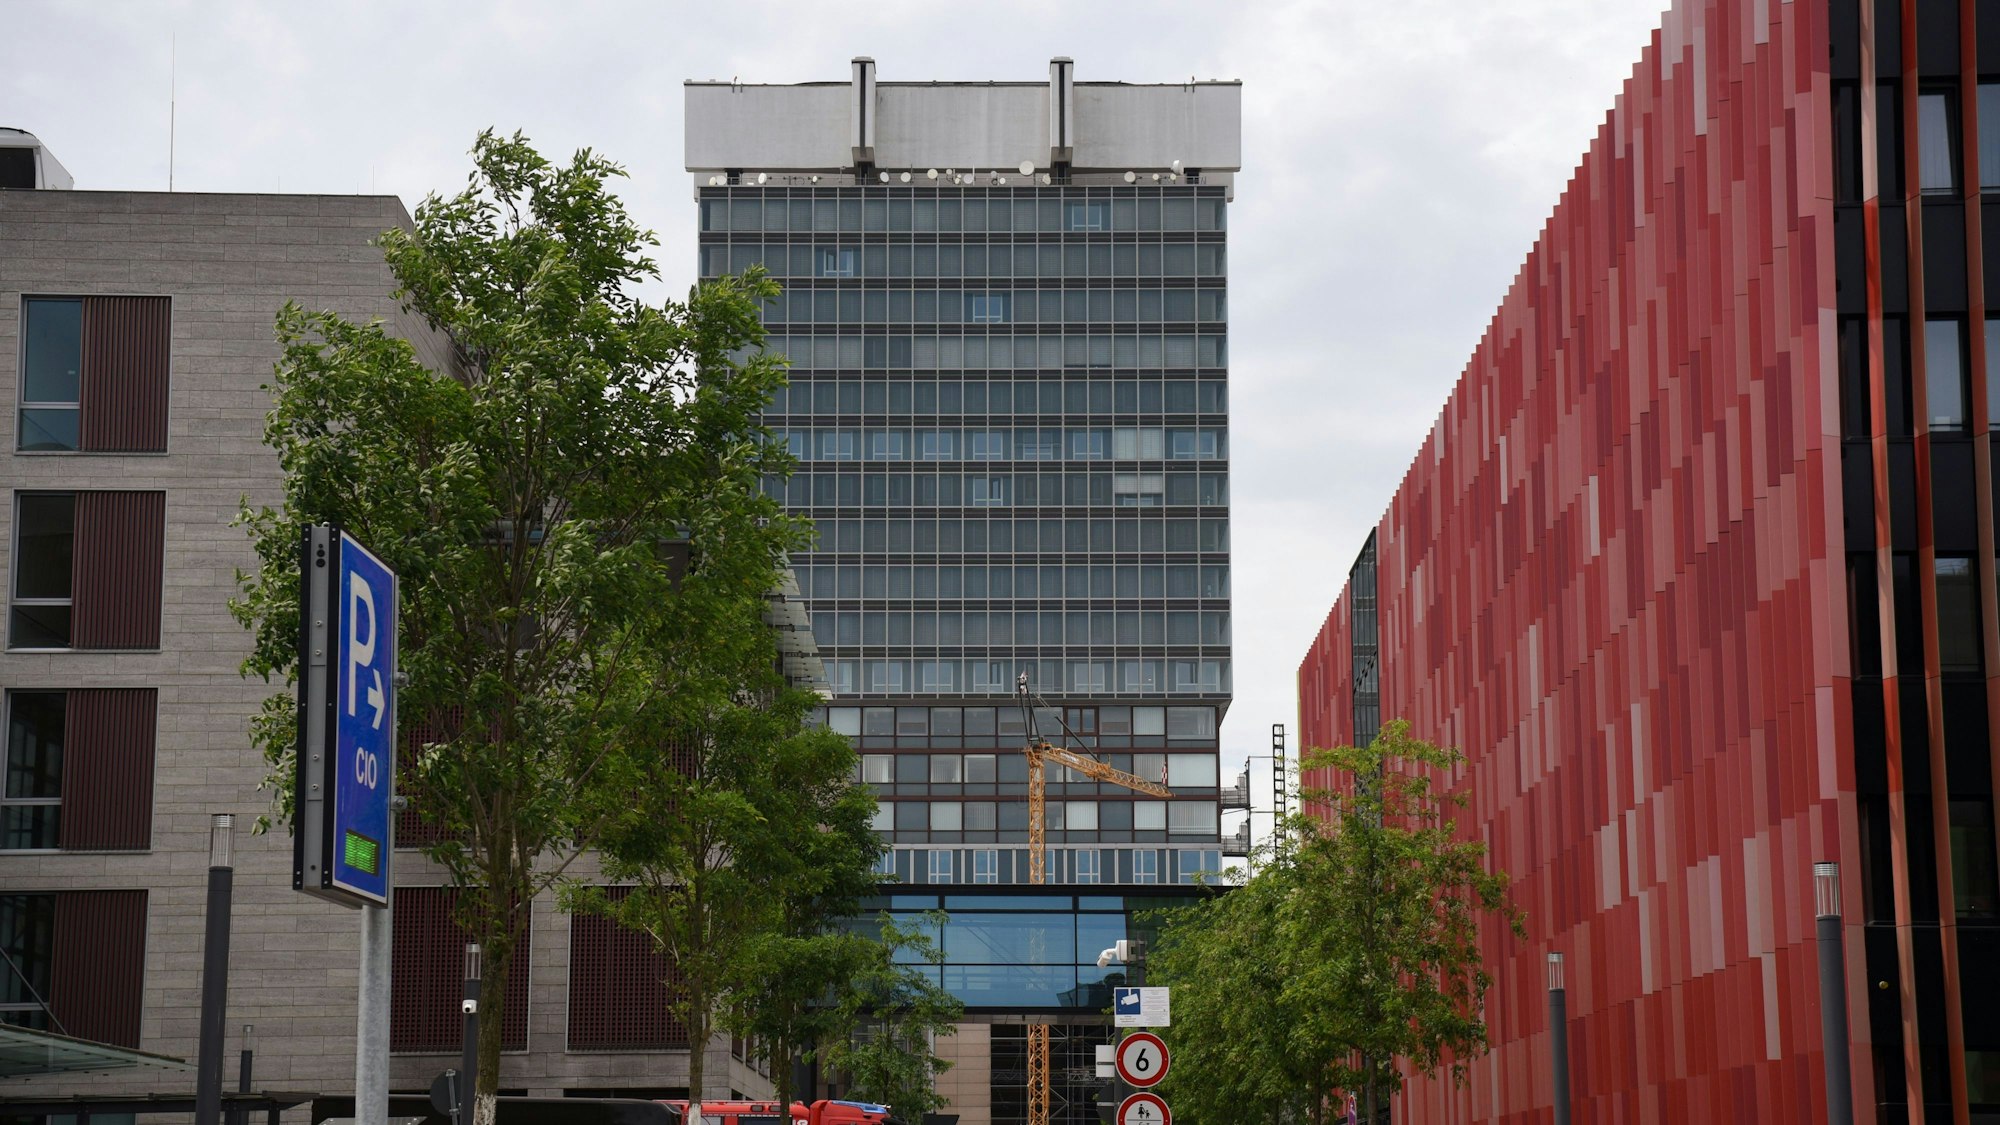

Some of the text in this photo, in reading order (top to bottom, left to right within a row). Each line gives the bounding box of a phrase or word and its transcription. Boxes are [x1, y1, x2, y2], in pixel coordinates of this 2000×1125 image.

[348, 570, 376, 717] P
[355, 746, 378, 790] CIO
[1135, 1048, 1149, 1072] 6
